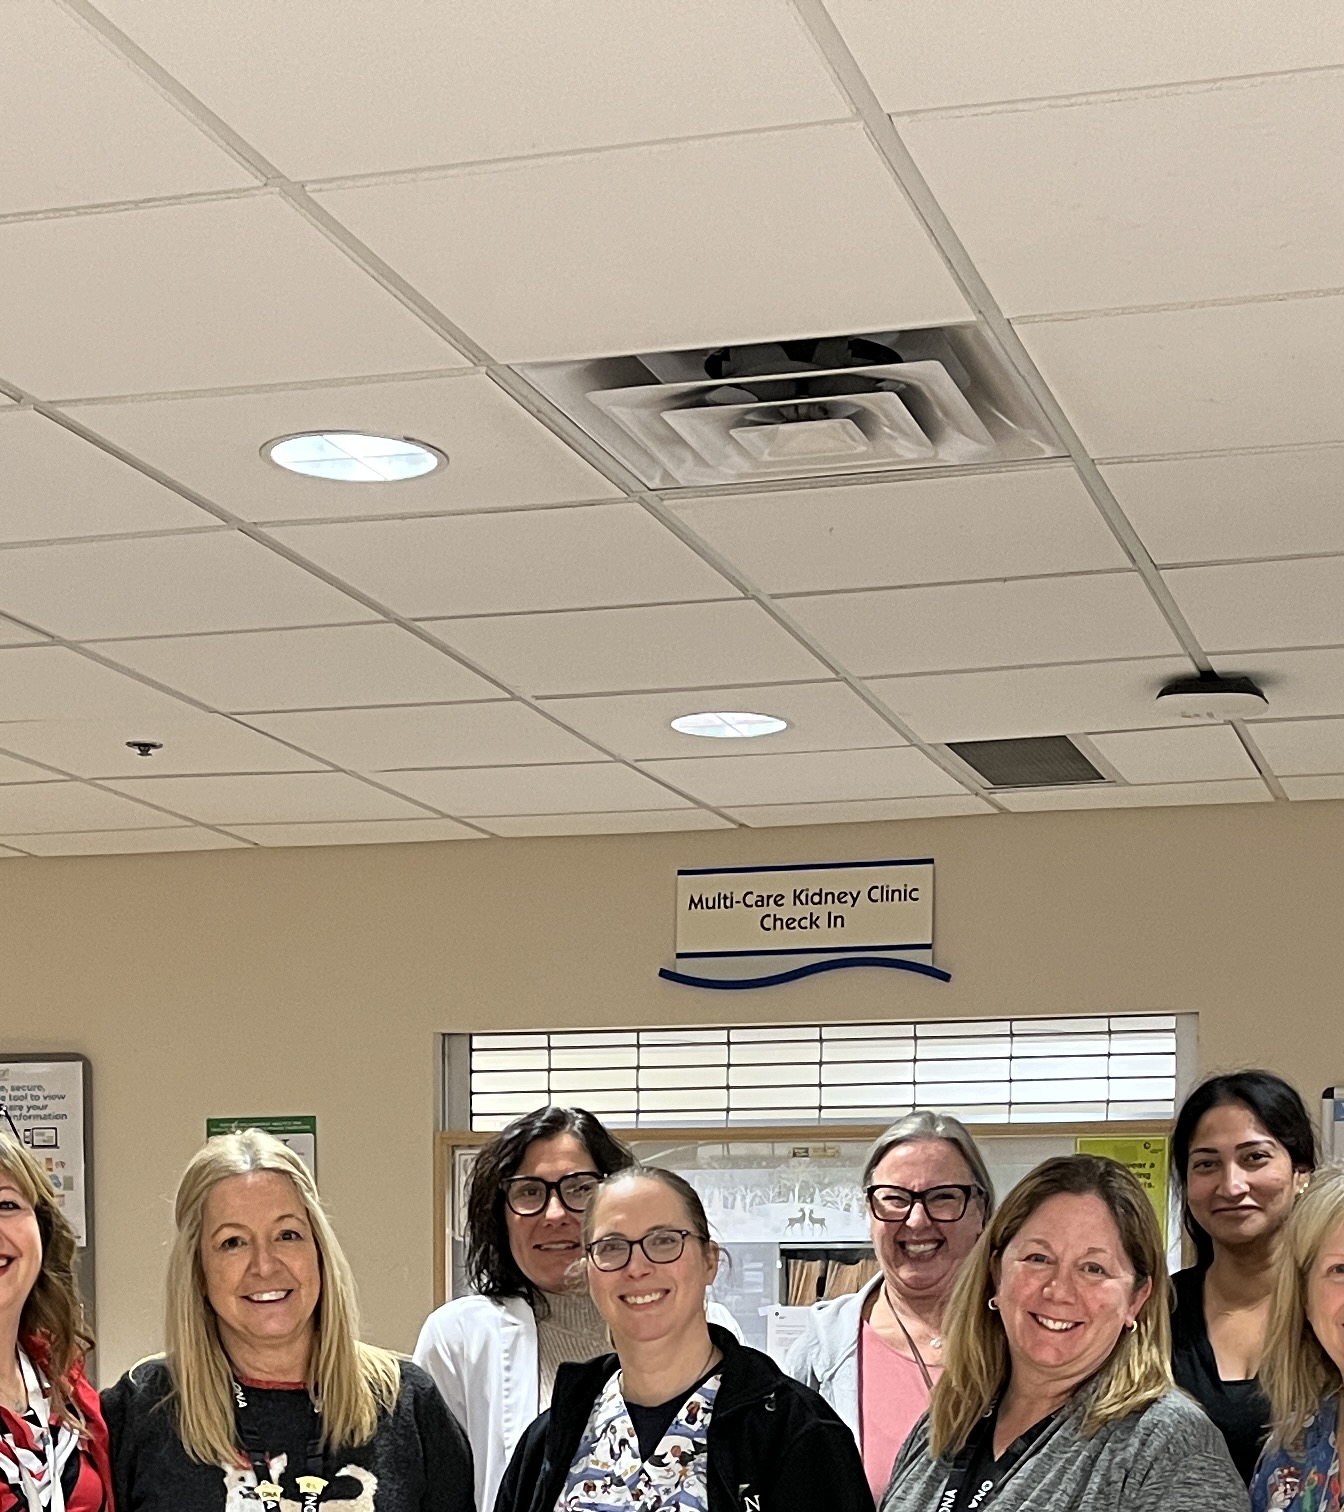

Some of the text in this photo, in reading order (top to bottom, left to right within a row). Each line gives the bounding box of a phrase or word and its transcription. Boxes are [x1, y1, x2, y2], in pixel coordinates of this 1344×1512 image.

[688, 883, 920, 910] Multi-Care Kidney Clinic
[759, 911, 845, 931] Check In
[10, 1084, 46, 1093] secure,
[8, 1093, 27, 1101] tool
[30, 1093, 41, 1101] to
[26, 1104, 49, 1113] your
[12, 1112, 67, 1120] nformation
[968, 1480, 994, 1509] ONA
